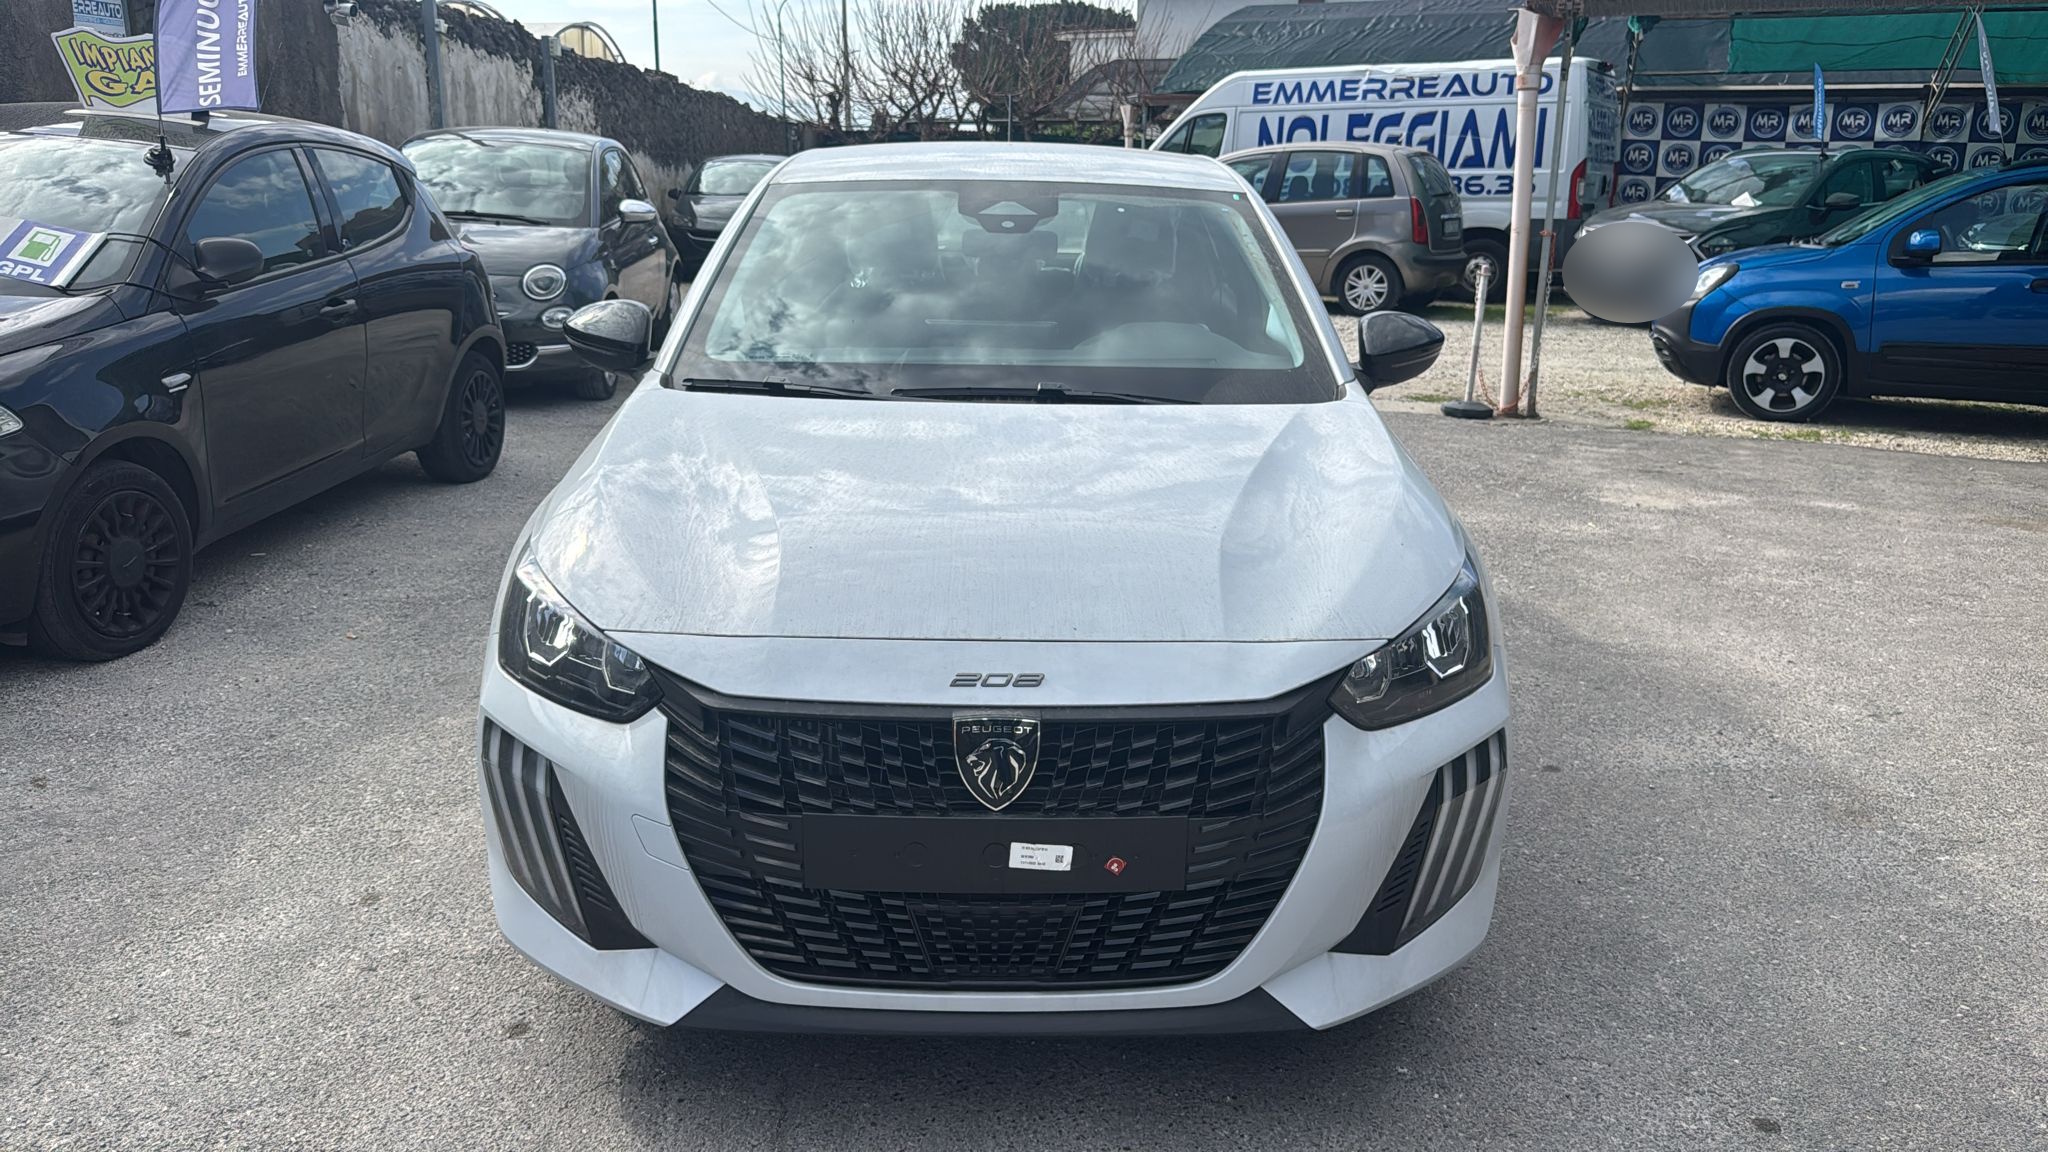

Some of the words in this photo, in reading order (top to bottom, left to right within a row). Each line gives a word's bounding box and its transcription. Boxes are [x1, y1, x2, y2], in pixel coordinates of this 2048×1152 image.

[1632, 112, 1653, 127] MR
[1672, 113, 1694, 128] MR
[1712, 114, 1736, 128] MR
[1756, 114, 1779, 128] MR
[1842, 114, 1866, 129] MR
[1887, 113, 1911, 127] MR
[1936, 114, 1960, 128] MR
[1628, 149, 1649, 163] MR
[1667, 150, 1689, 165] MR
[1624, 185, 1645, 199] MR
[0, 261, 45, 281] GPL
[949, 672, 1045, 688] 208
[961, 725, 1033, 735] PEUGEOT
